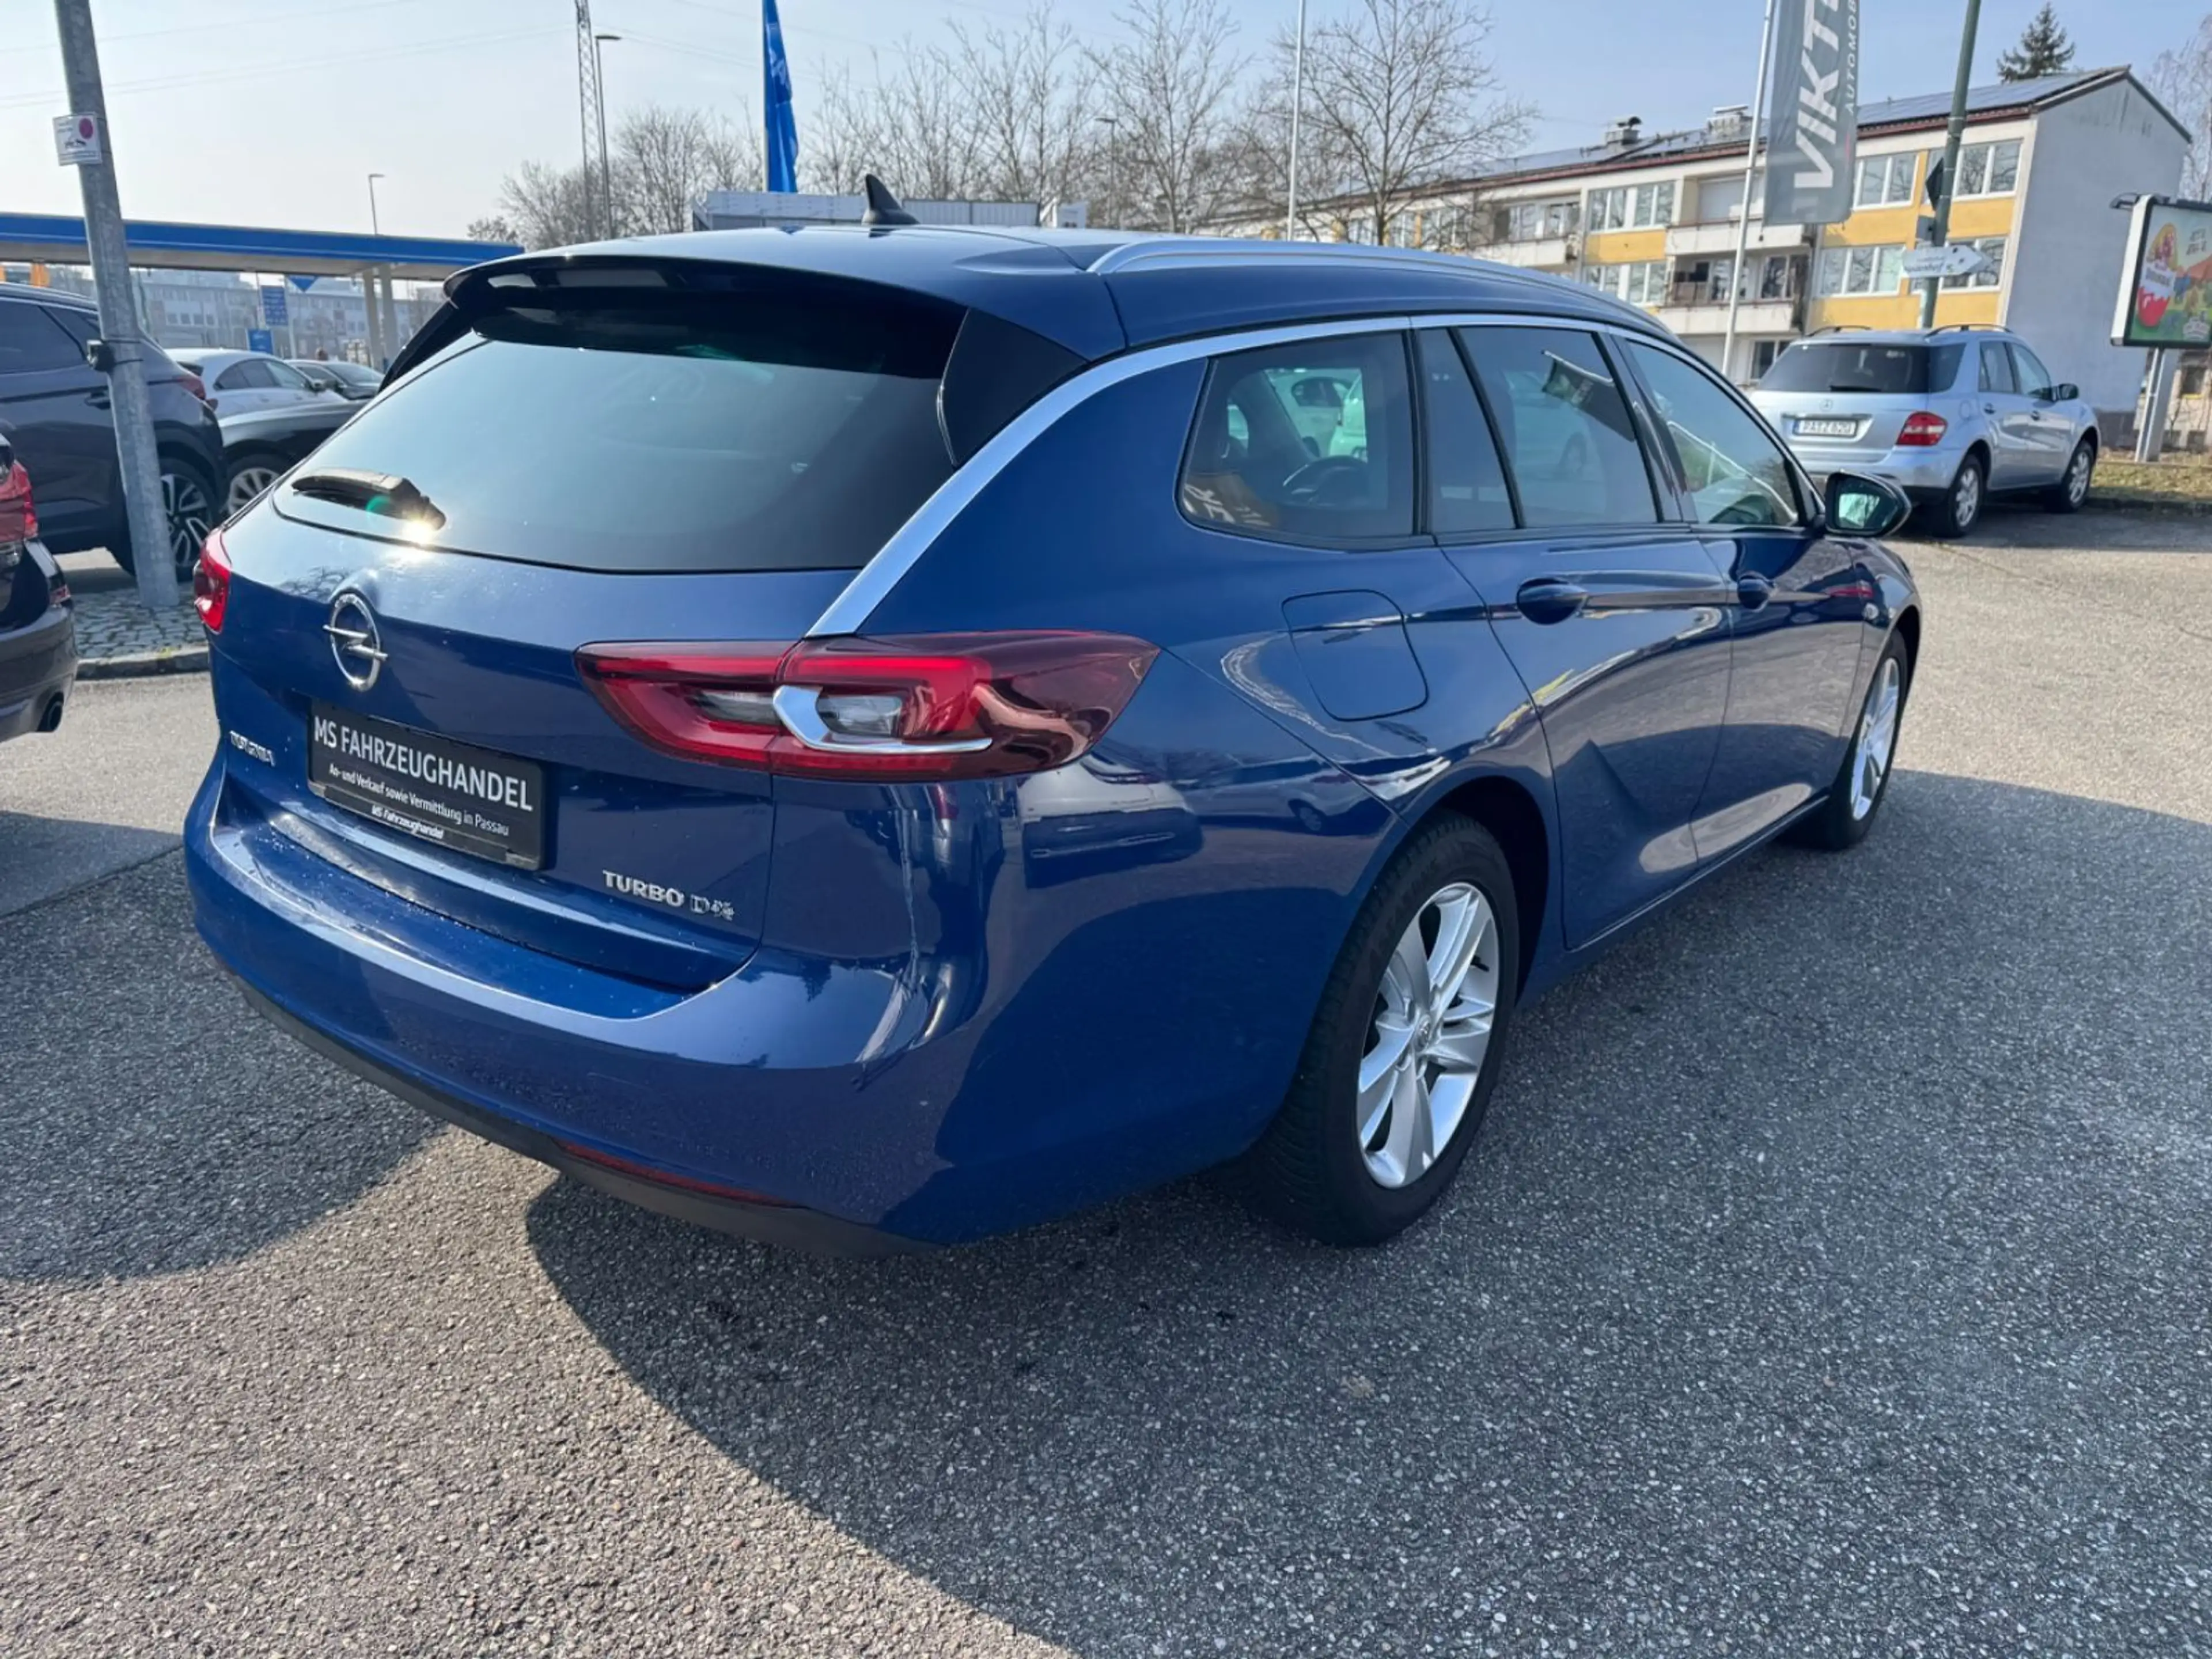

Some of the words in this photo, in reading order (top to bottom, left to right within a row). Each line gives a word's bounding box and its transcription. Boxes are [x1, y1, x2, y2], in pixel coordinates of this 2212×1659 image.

[1794, 0, 1839, 188] VIKT
[315, 715, 337, 748] MS
[340, 725, 533, 812] FAHRZEUGHANDEL
[342, 770, 356, 785] und
[357, 773, 385, 795] Verkauf
[409, 791, 461, 825] Vermittlung
[463, 810, 474, 825] in
[475, 813, 509, 836] Passau
[603, 869, 685, 907] TURBO
